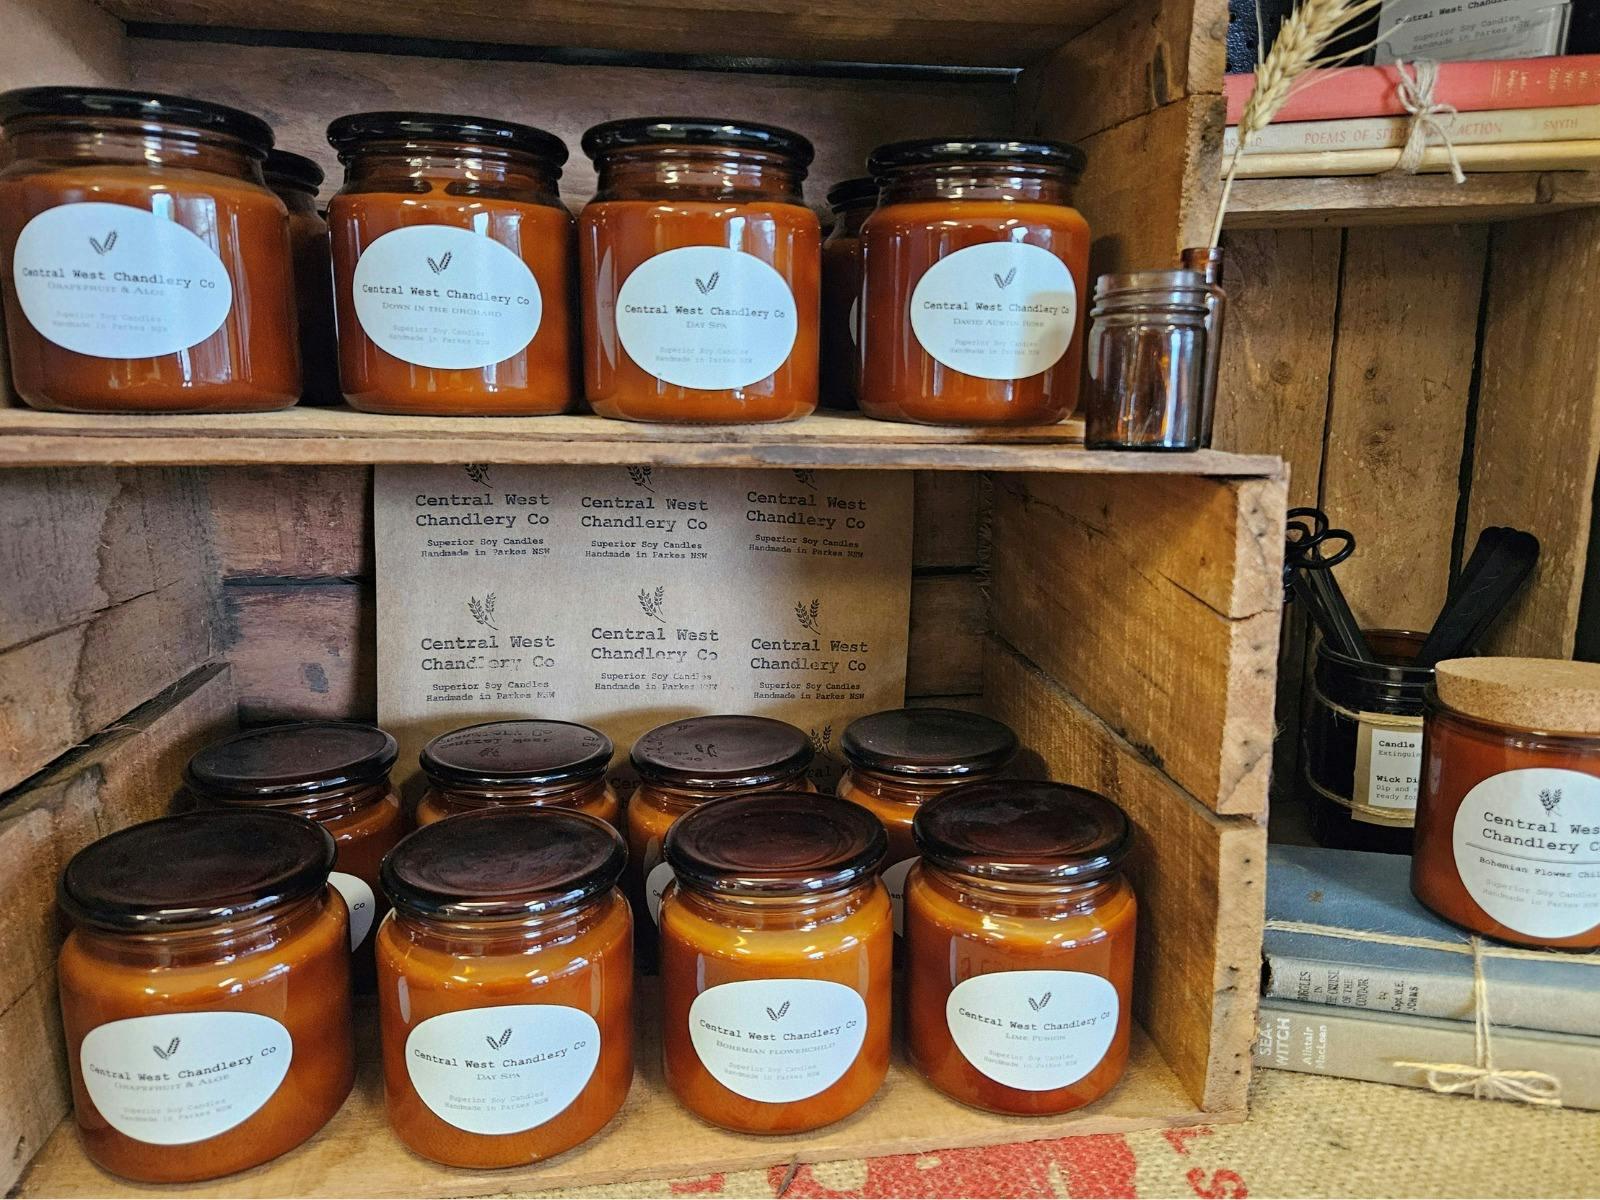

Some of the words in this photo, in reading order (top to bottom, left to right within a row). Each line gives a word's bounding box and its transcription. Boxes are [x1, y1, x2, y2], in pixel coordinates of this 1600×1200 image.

[1439, 6, 1463, 16] West
[1544, 118, 1578, 130] SMYTH
[1304, 131, 1345, 144] POEMS
[1353, 130, 1370, 141] OF
[22, 267, 65, 279] Central
[73, 270, 106, 280] West
[113, 272, 192, 289] Chandlery
[199, 279, 215, 289] Co
[362, 284, 404, 295] Central
[411, 287, 440, 298] West
[447, 290, 511, 306] Chandlery
[517, 296, 530, 306] Co
[625, 304, 669, 314] Central
[675, 305, 703, 315] West
[711, 306, 769, 320] Chandlery
[774, 310, 785, 318] Co
[924, 301, 968, 311] Central
[976, 302, 1002, 311] West
[1009, 304, 1058, 316] Chandlery
[1062, 306, 1069, 315] Co
[415, 493, 493, 506] Central
[505, 493, 550, 505] West
[581, 496, 655, 509] Central
[665, 498, 709, 511] West
[747, 491, 817, 507] Central
[826, 496, 867, 511] West
[415, 513, 516, 528] Chandlery
[528, 513, 550, 525] Co
[581, 516, 677, 532] Chandlery
[687, 518, 708, 530] Co
[746, 510, 838, 530] Chandlery
[846, 517, 866, 529] Co
[427, 539, 474, 548] Superior
[480, 538, 497, 547] Soy
[503, 537, 544, 545] Candles
[591, 540, 636, 549] Superior
[641, 541, 658, 549] Soy
[663, 541, 702, 549] Candles
[755, 534, 797, 544] Superior
[802, 537, 818, 547] Soy
[823, 539, 859, 548] Candles
[421, 549, 469, 557] Handmade
[532, 547, 550, 555] NSW
[585, 550, 631, 558] Handmade
[652, 551, 686, 559] Parkes
[749, 544, 791, 553] Handmade
[812, 549, 843, 557] Parkes
[591, 627, 666, 640] Central
[676, 628, 719, 641] West
[421, 635, 499, 650] Central
[509, 635, 555, 648] West
[751, 638, 821, 651] Central
[830, 640, 869, 653] West
[532, 655, 555, 668] Co
[591, 647, 688, 663] Chandlery
[697, 648, 718, 661] Co
[750, 657, 840, 674] Chandlery
[848, 660, 867, 671] Co
[601, 672, 646, 681] Superior
[651, 672, 669, 681] Soy
[432, 682, 480, 692] Superior
[485, 682, 502, 690] Soy
[508, 681, 549, 689] Candles
[594, 682, 640, 690] Handmade
[662, 682, 696, 690] Parkes
[759, 682, 801, 691] Superior
[805, 682, 823, 691] Soy
[426, 692, 474, 701] Handmade
[753, 691, 796, 699] Handmade
[815, 692, 846, 700] Parkes
[1378, 740, 1415, 749] Candle
[1378, 750, 1420, 758] Extingui
[1376, 775, 1400, 783] Wick
[1406, 776, 1417, 784] Di
[1483, 811, 1558, 833] Central
[1570, 823, 1600, 835] Wes
[1482, 828, 1580, 854] Chandlery
[1479, 856, 1528, 873] Bohemian
[1534, 868, 1572, 879] Flower
[1577, 871, 1600, 879] Chil
[959, 1008, 1003, 1027] Central
[1010, 1021, 1037, 1031] West
[1043, 1016, 1097, 1031] Chandlery
[1101, 1011, 1110, 1020] Co
[700, 1019, 741, 1038] Central
[748, 1032, 776, 1040] West
[783, 1026, 841, 1041] Chandlery
[846, 1021, 857, 1029] Co
[1276, 1017, 1290, 1067] WITCH
[1315, 1024, 1328, 1069] MacLean
[414, 1049, 458, 1068] Central
[465, 1060, 495, 1069] West
[502, 1048, 568, 1069] Chandlery
[573, 1041, 586, 1051] Co
[90, 1063, 131, 1081] Central
[138, 1073, 170, 1081] West
[178, 1055, 254, 1079] Chandlery
[261, 1046, 277, 1057] Co
